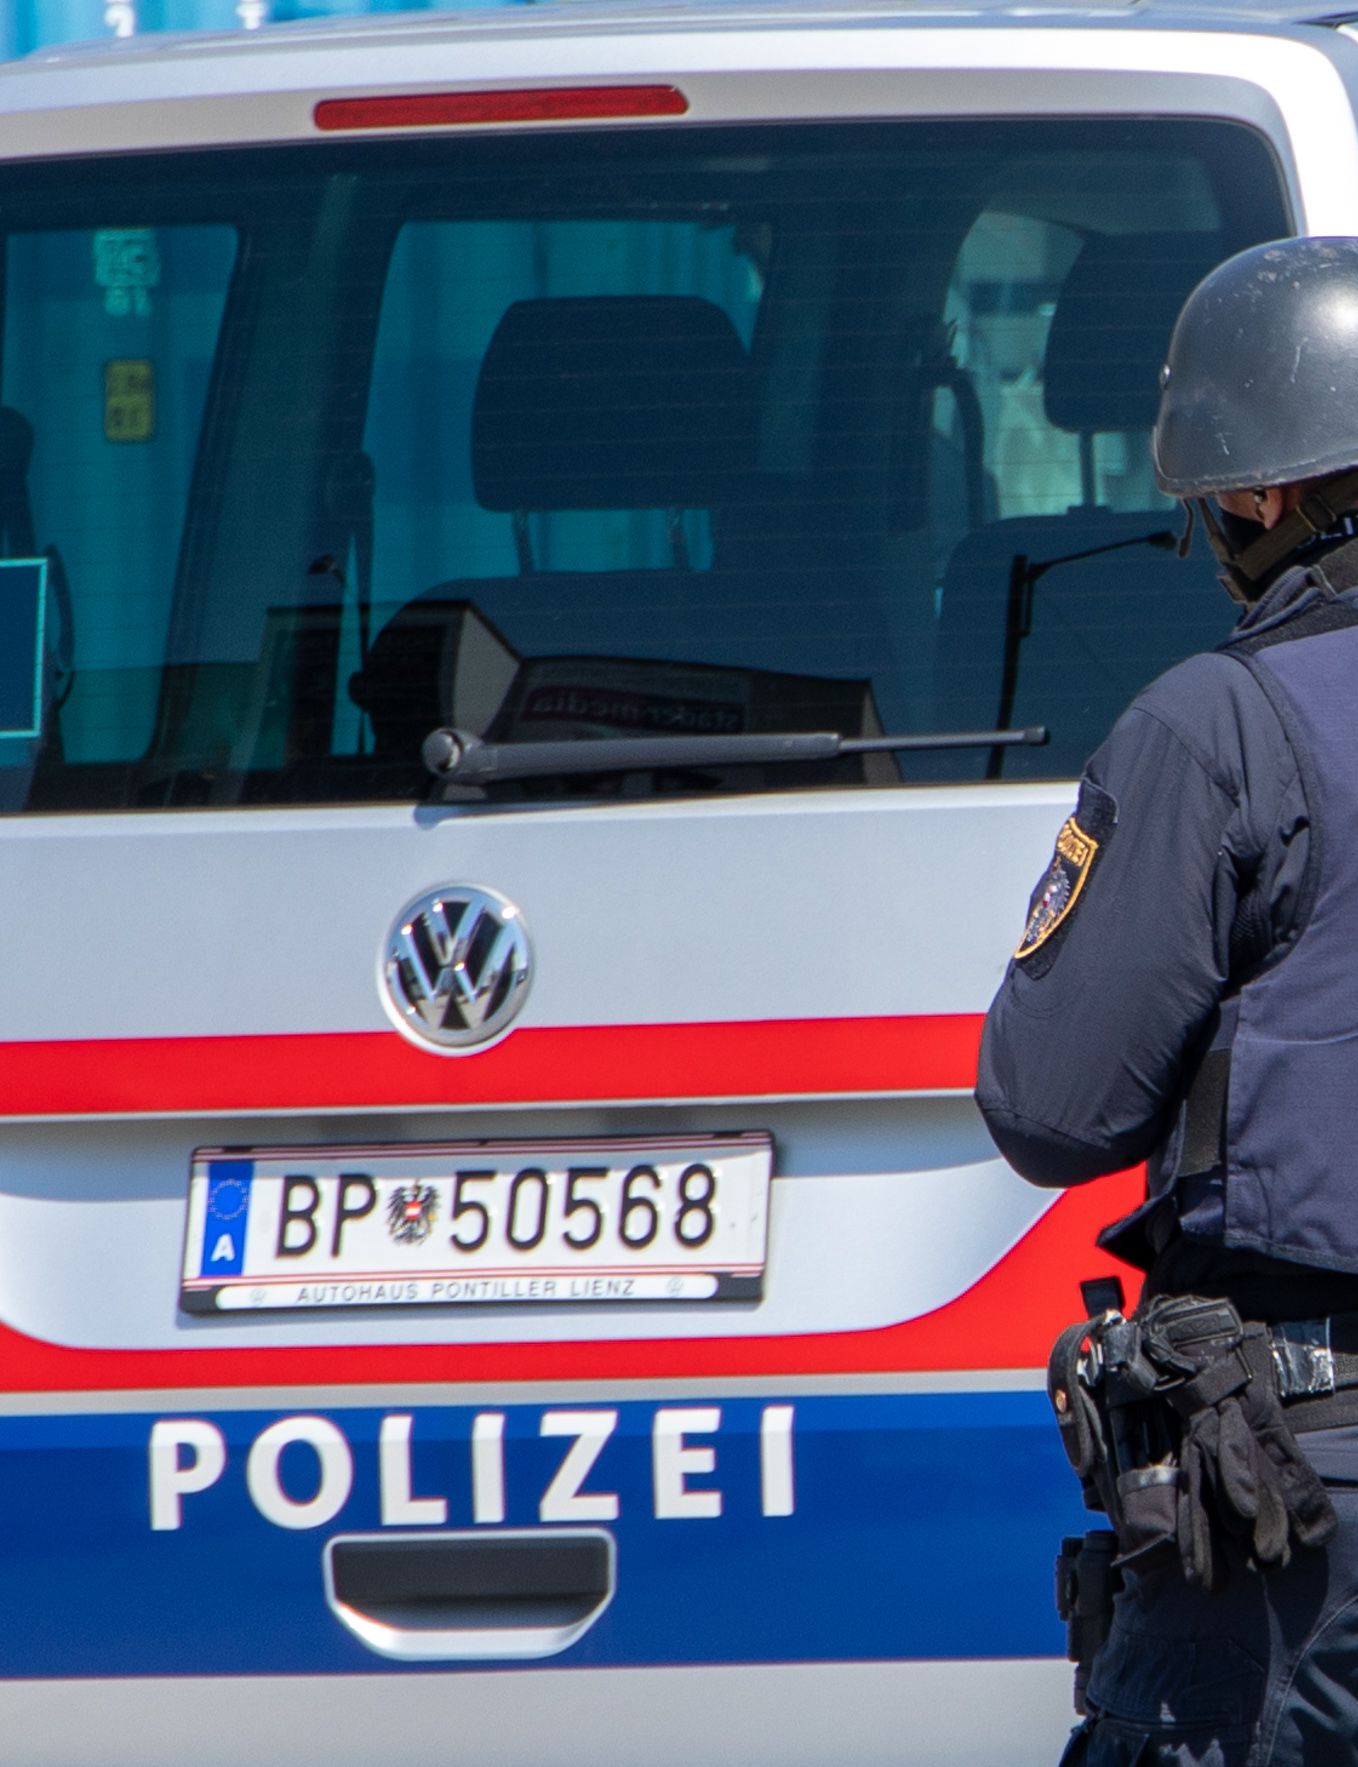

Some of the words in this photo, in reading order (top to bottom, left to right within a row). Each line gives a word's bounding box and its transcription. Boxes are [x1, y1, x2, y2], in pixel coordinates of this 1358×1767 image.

[383, 886, 531, 1044] VW
[210, 1232, 235, 1263] A
[275, 1174, 377, 1260] BP
[450, 1163, 716, 1252] 50568
[296, 1283, 418, 1304] AUTOHAUS
[431, 1280, 557, 1300] PONTILLER
[570, 1278, 637, 1297] LIENZ
[149, 1405, 794, 1531] POLIZEI
